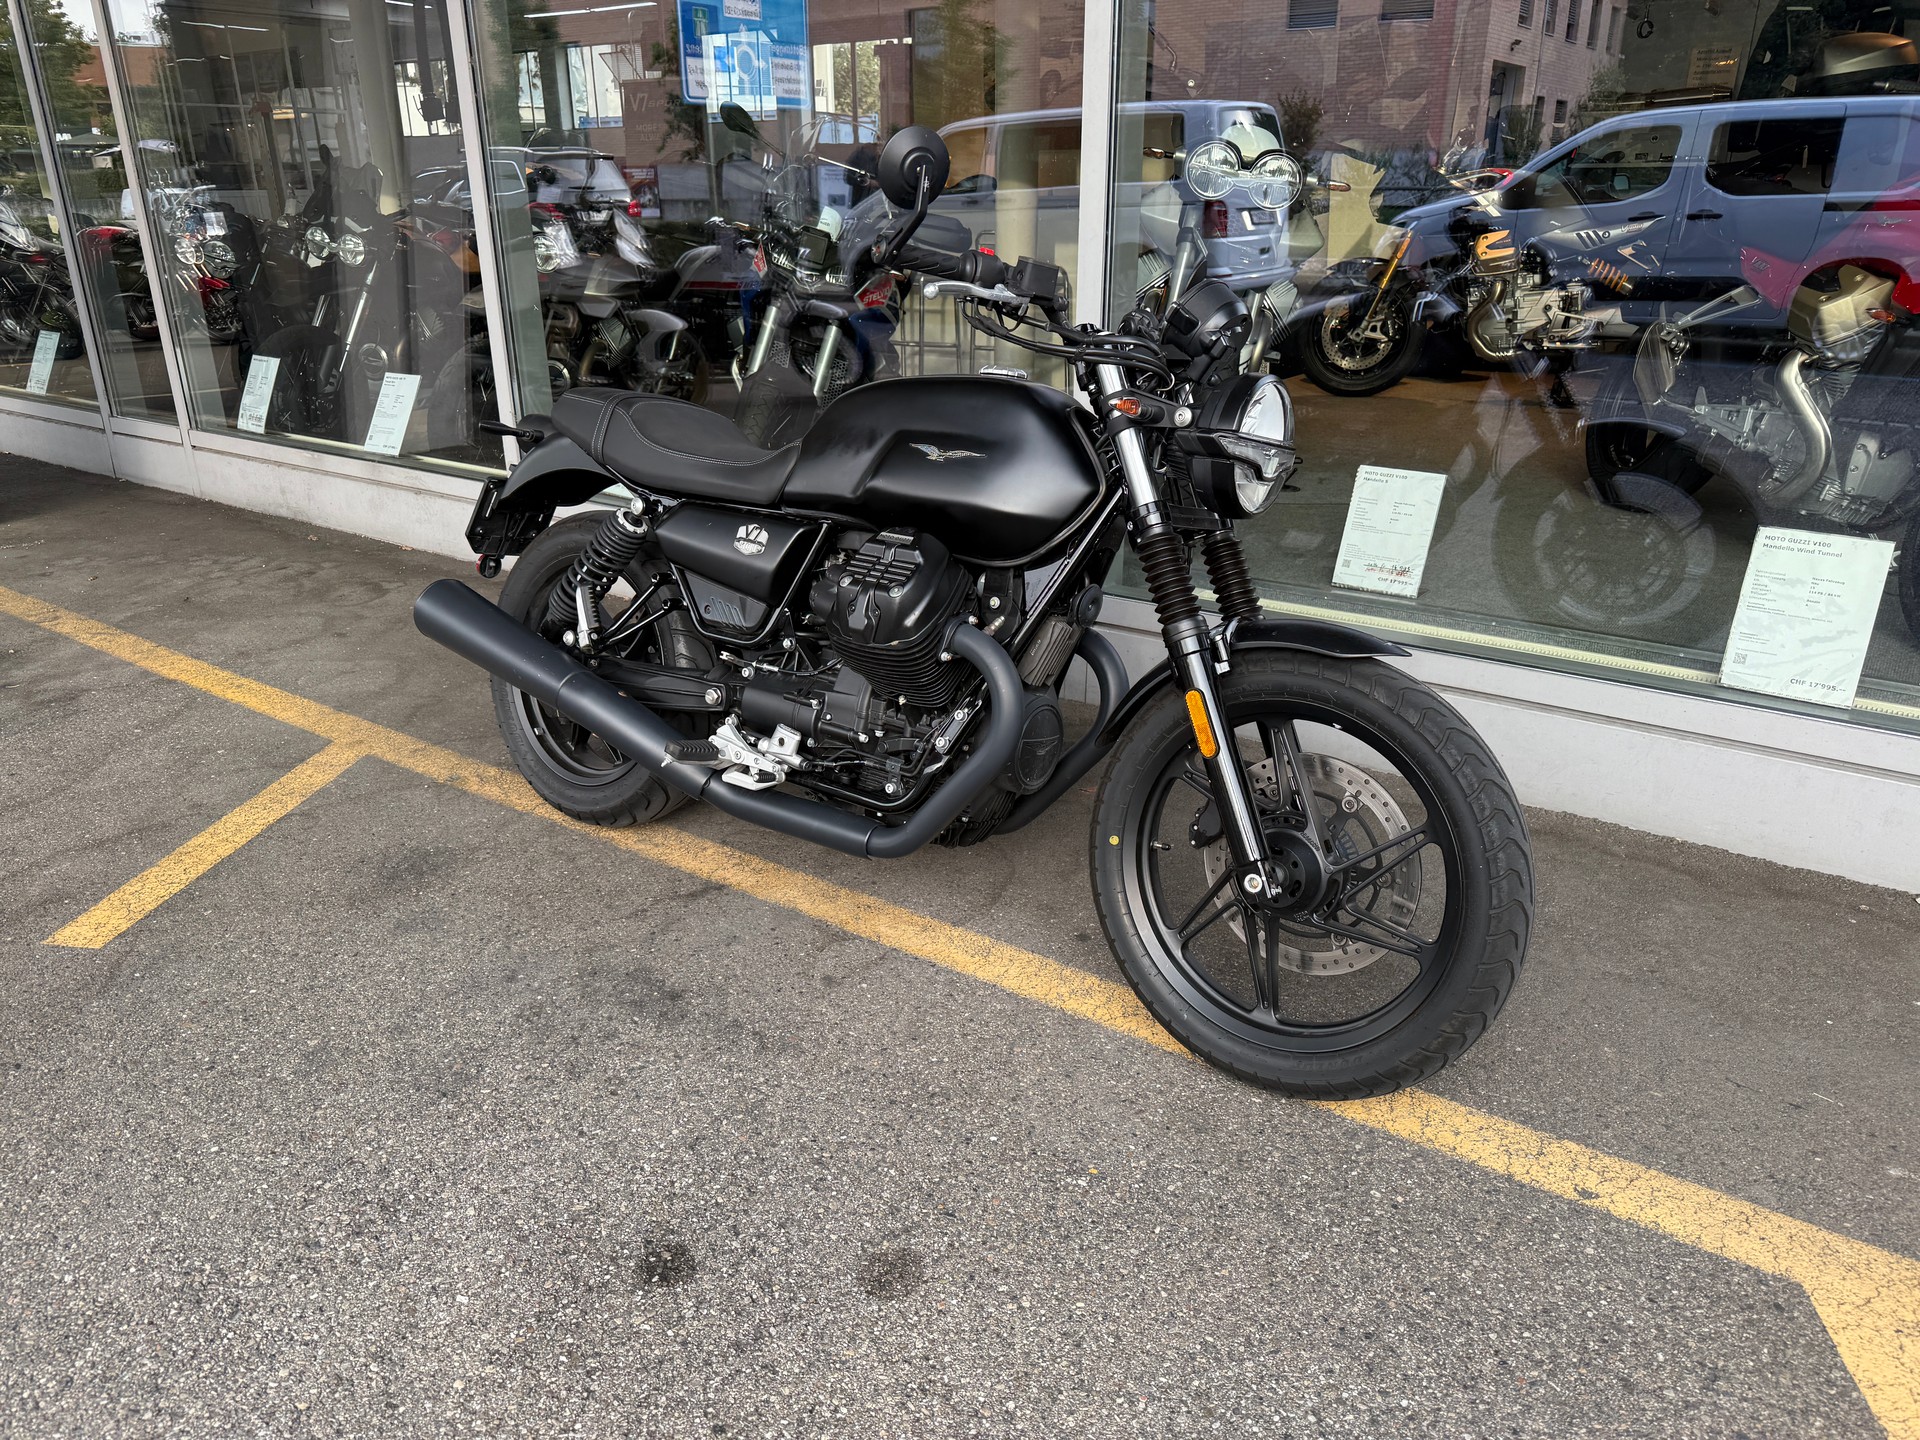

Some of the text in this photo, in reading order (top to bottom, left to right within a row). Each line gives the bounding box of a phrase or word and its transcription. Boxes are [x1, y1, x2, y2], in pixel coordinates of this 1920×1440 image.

[629, 93, 681, 112] V7 SPOR
[745, 524, 763, 541] V7
[1765, 535, 1832, 548] MOTO GUZZI V100
[1762, 543, 1843, 558] Mandello Wind Tunnel
[1789, 677, 1807, 688] CHF
